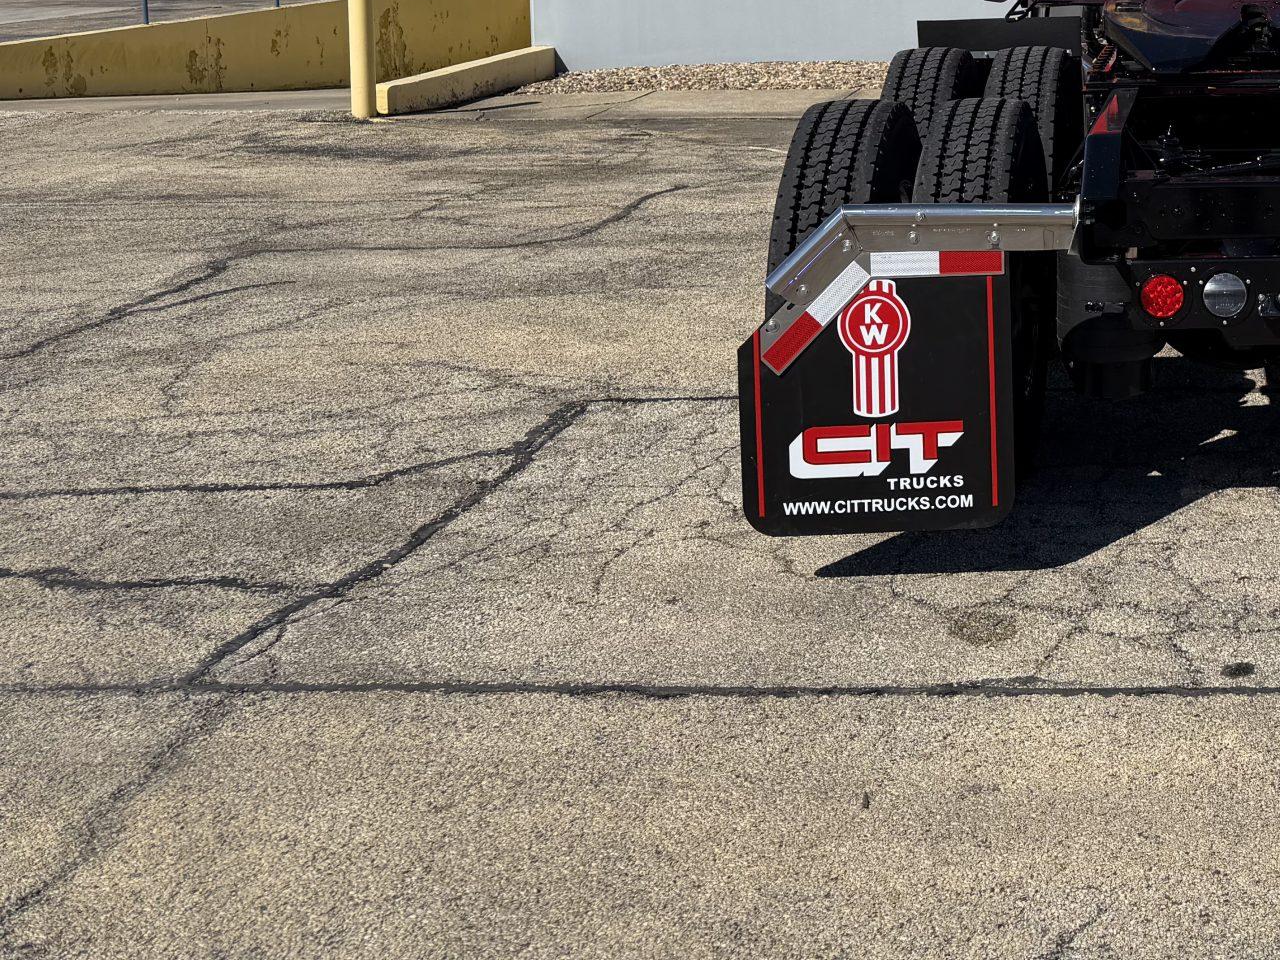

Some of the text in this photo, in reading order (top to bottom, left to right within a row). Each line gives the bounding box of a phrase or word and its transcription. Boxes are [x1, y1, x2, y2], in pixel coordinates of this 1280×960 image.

[864, 303, 882, 324] K
[859, 324, 889, 346] W
[795, 420, 964, 473] CIT
[886, 475, 965, 491] TRUCKS
[783, 494, 974, 517] WWW.CITTRUCKS.COM
